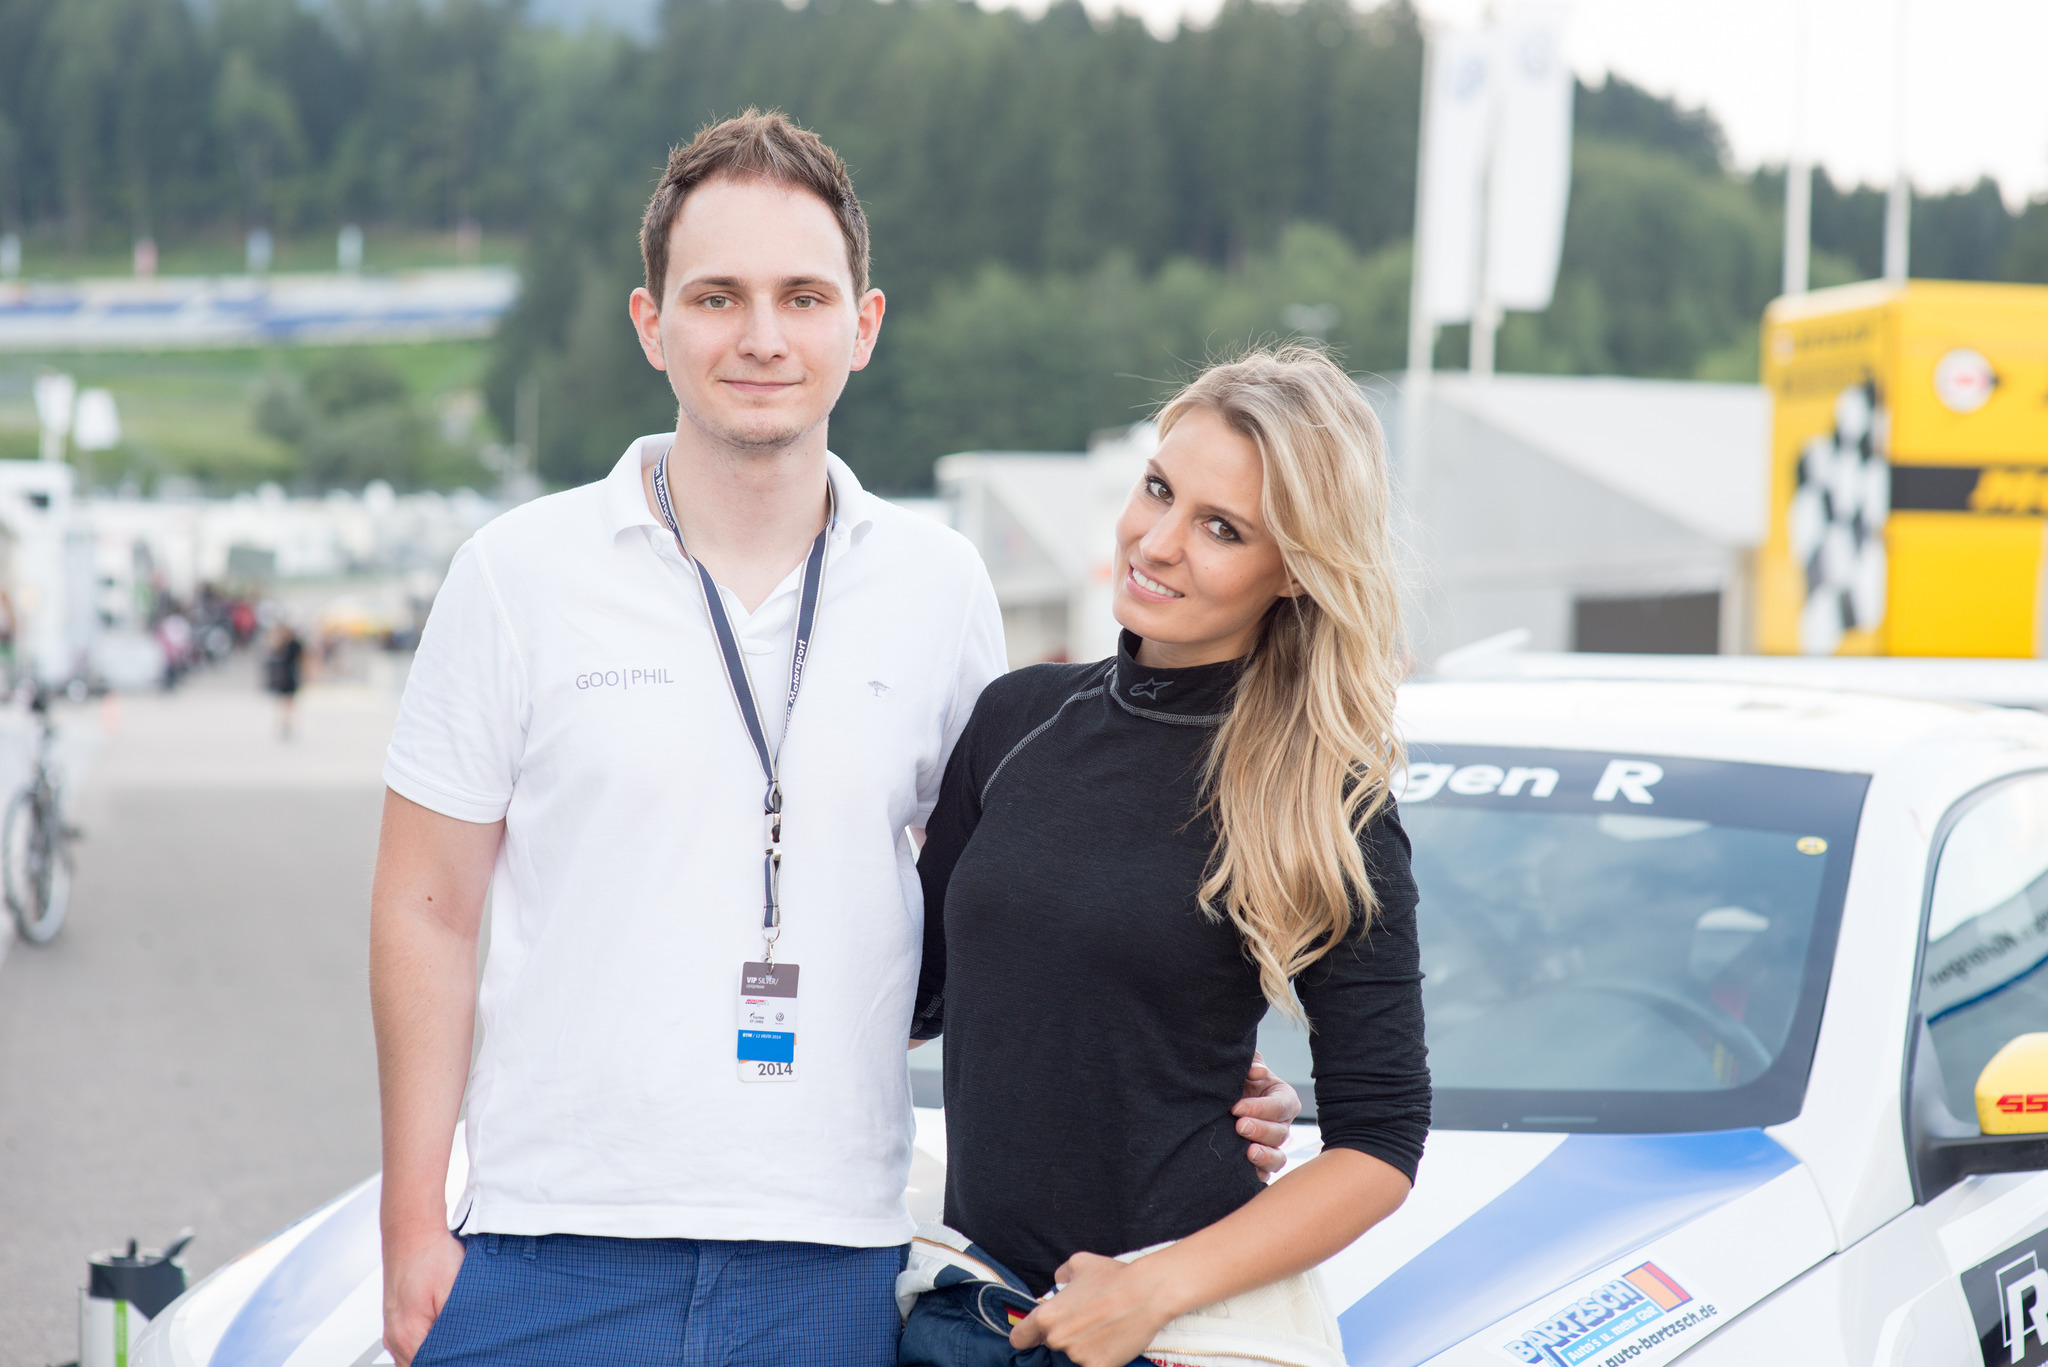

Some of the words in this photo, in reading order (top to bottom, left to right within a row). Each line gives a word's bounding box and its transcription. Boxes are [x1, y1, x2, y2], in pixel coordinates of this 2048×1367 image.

[788, 639, 807, 704] Motorsport
[1592, 759, 1664, 804] R
[746, 976, 757, 984] VIP
[757, 1063, 793, 1076] 2014
[1503, 1279, 1645, 1364] BARTZSCH
[1611, 1316, 1638, 1336] mehr
